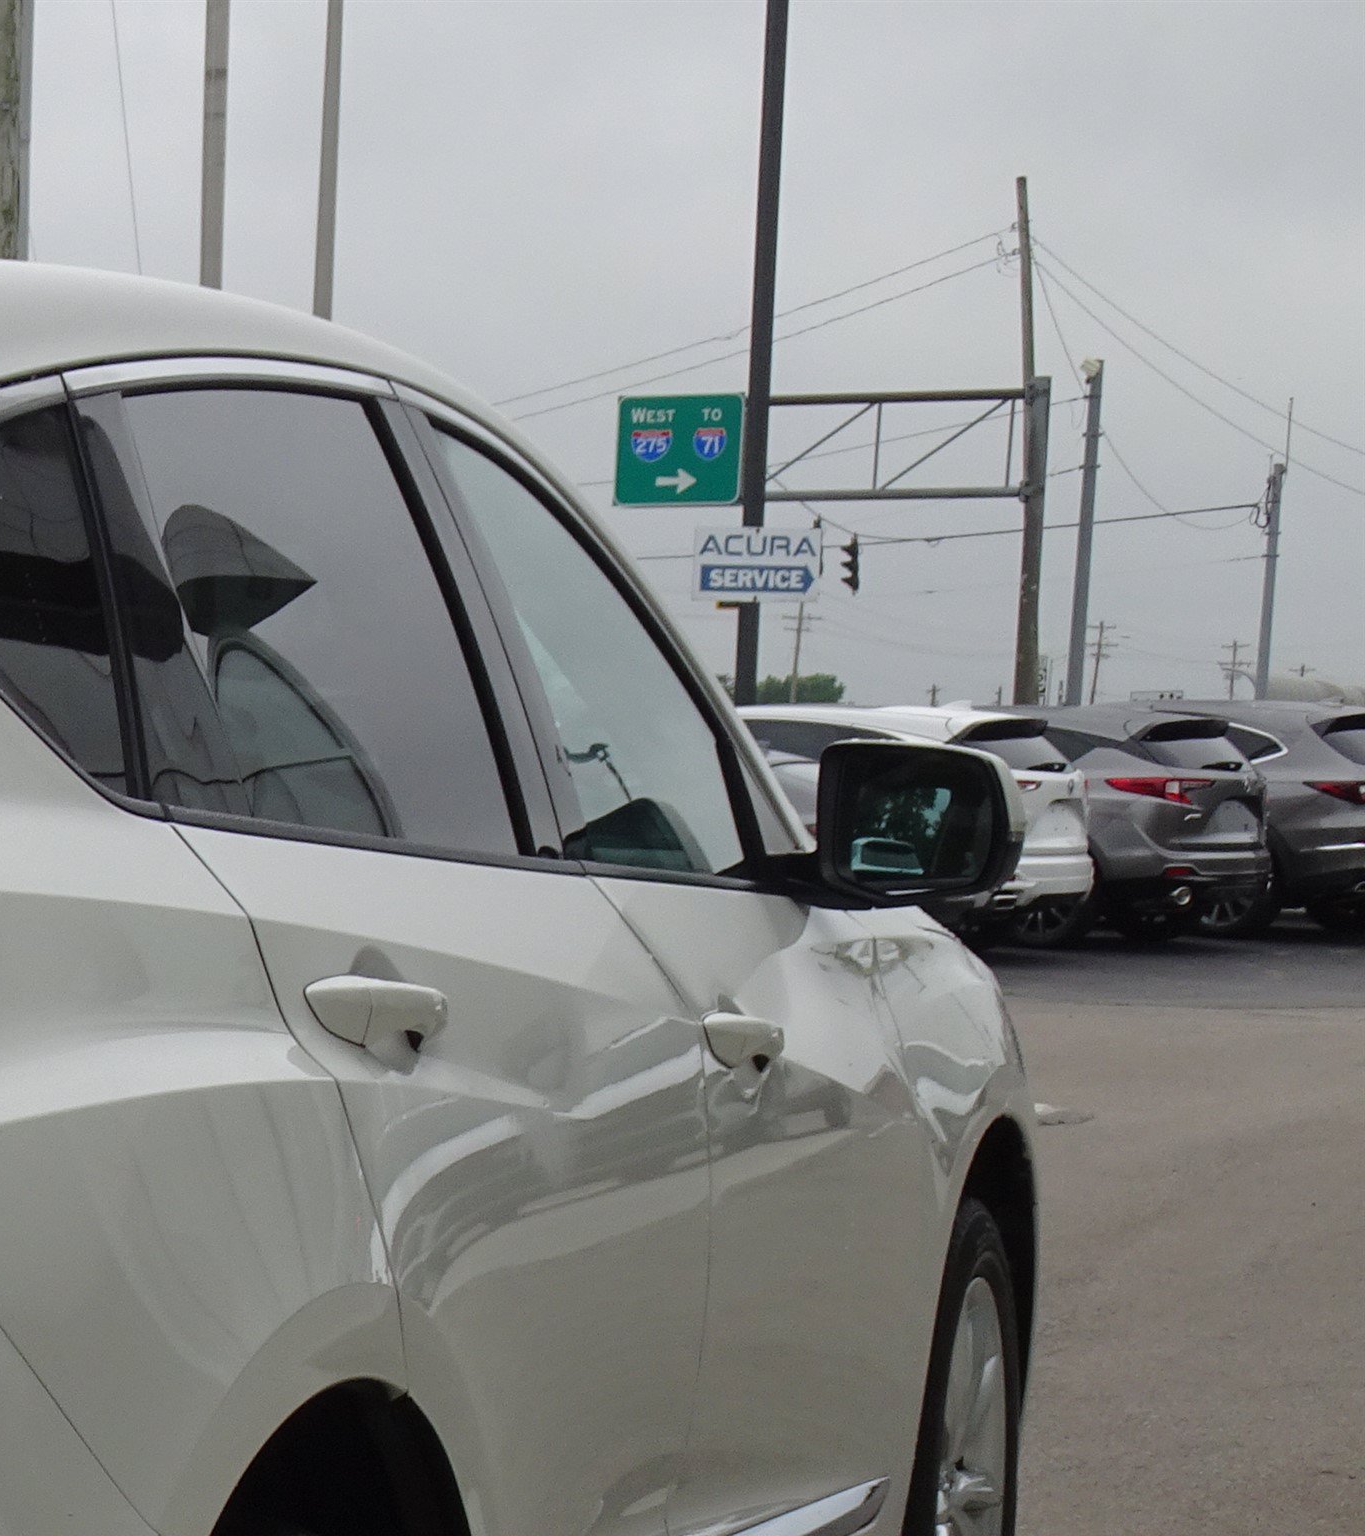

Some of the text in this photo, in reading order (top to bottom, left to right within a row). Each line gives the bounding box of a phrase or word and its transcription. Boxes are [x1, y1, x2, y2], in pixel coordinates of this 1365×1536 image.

[631, 407, 723, 424] WEST TO
[635, 436, 720, 454] 275 71
[699, 534, 817, 557] ACURA
[708, 569, 806, 590] SERVICE
